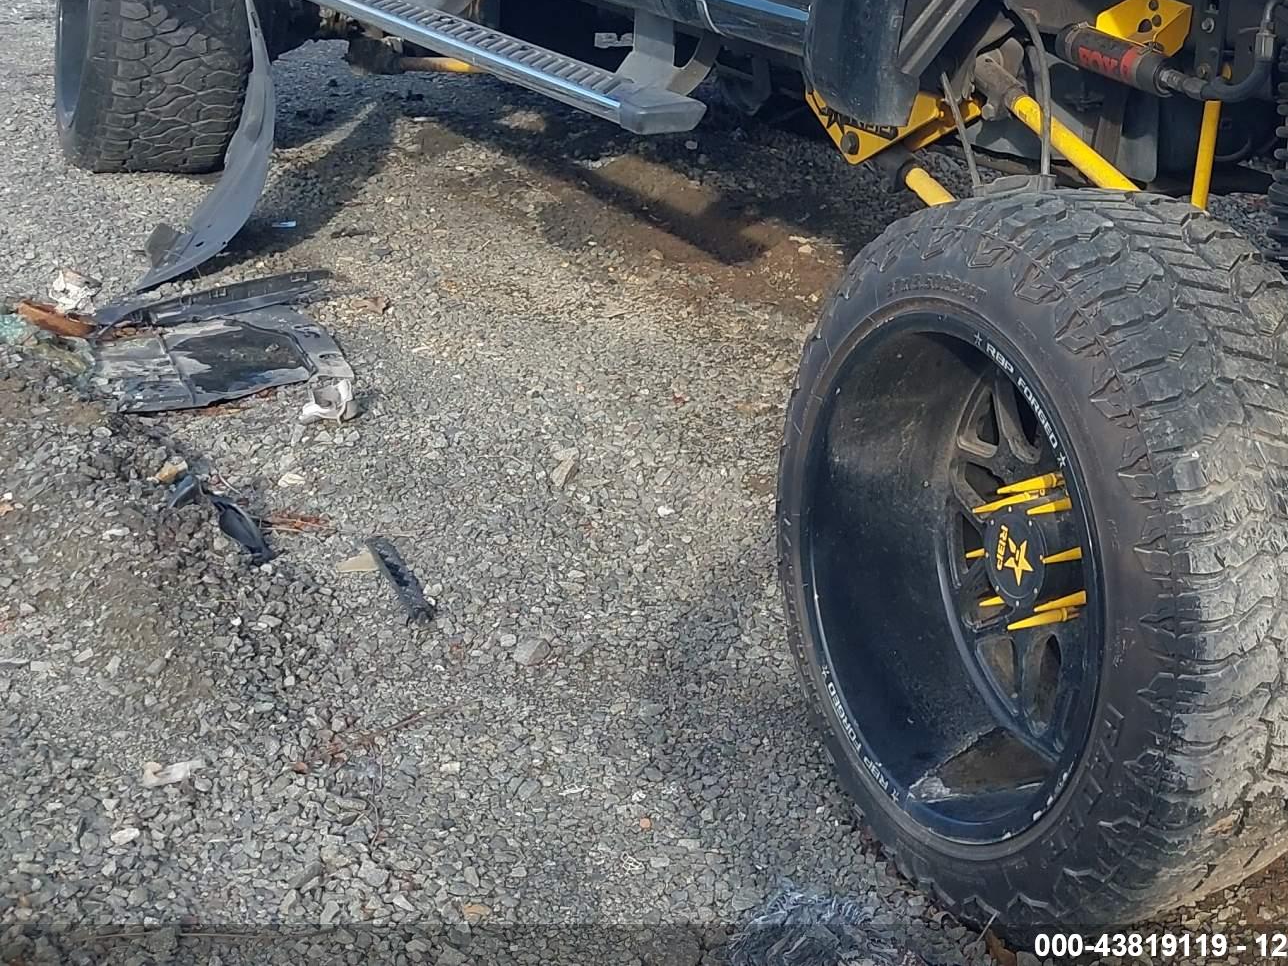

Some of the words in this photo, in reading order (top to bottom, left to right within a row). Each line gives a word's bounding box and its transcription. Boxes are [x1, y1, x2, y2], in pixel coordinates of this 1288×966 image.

[986, 343, 1014, 374] RBP
[1017, 376, 1058, 449] FORGED
[996, 525, 1009, 571] RBP
[827, 681, 862, 751] FORGED
[863, 756, 889, 791] RBP
